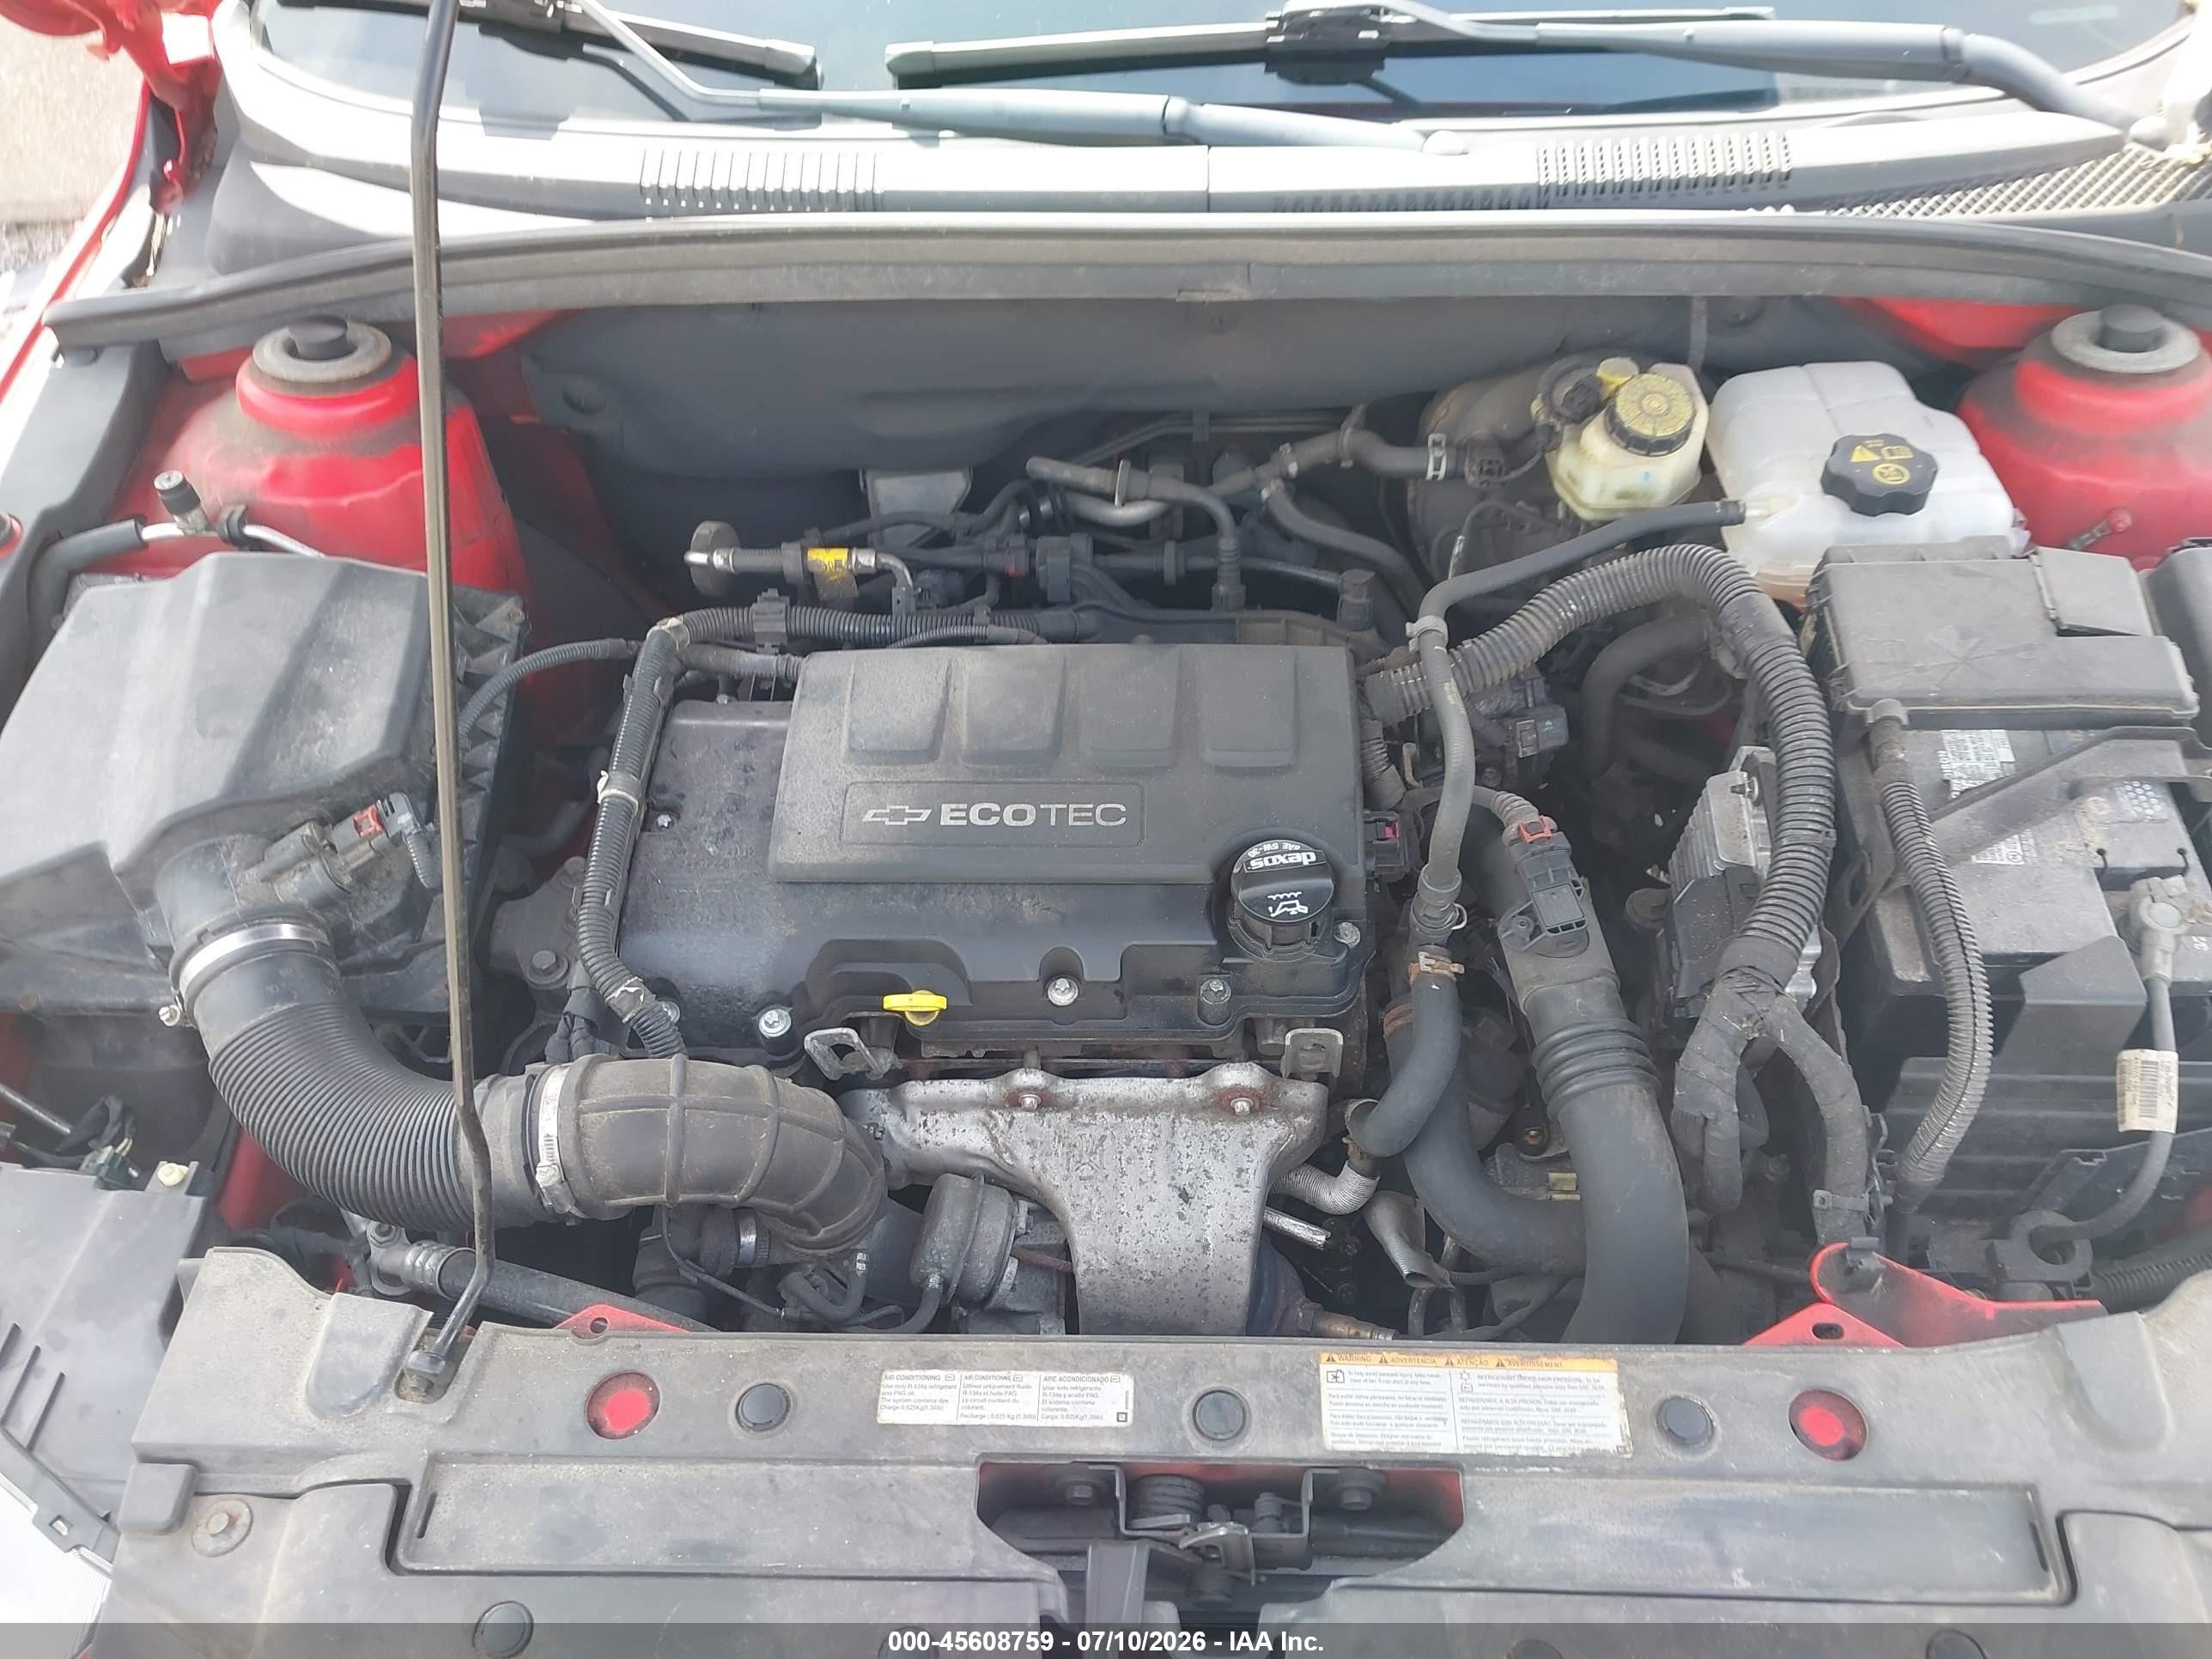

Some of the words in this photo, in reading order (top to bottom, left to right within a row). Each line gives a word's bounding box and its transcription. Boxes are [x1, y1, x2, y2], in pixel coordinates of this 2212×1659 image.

[939, 802, 1127, 827] ECOTEC
[1247, 842, 1279, 858] 5W-30
[1249, 851, 1317, 870] dexos
[1338, 1354, 1371, 1363] WARNING
[1390, 1355, 1437, 1364] ADVERTENCIA
[1456, 1358, 1489, 1367] ATENÇÃO
